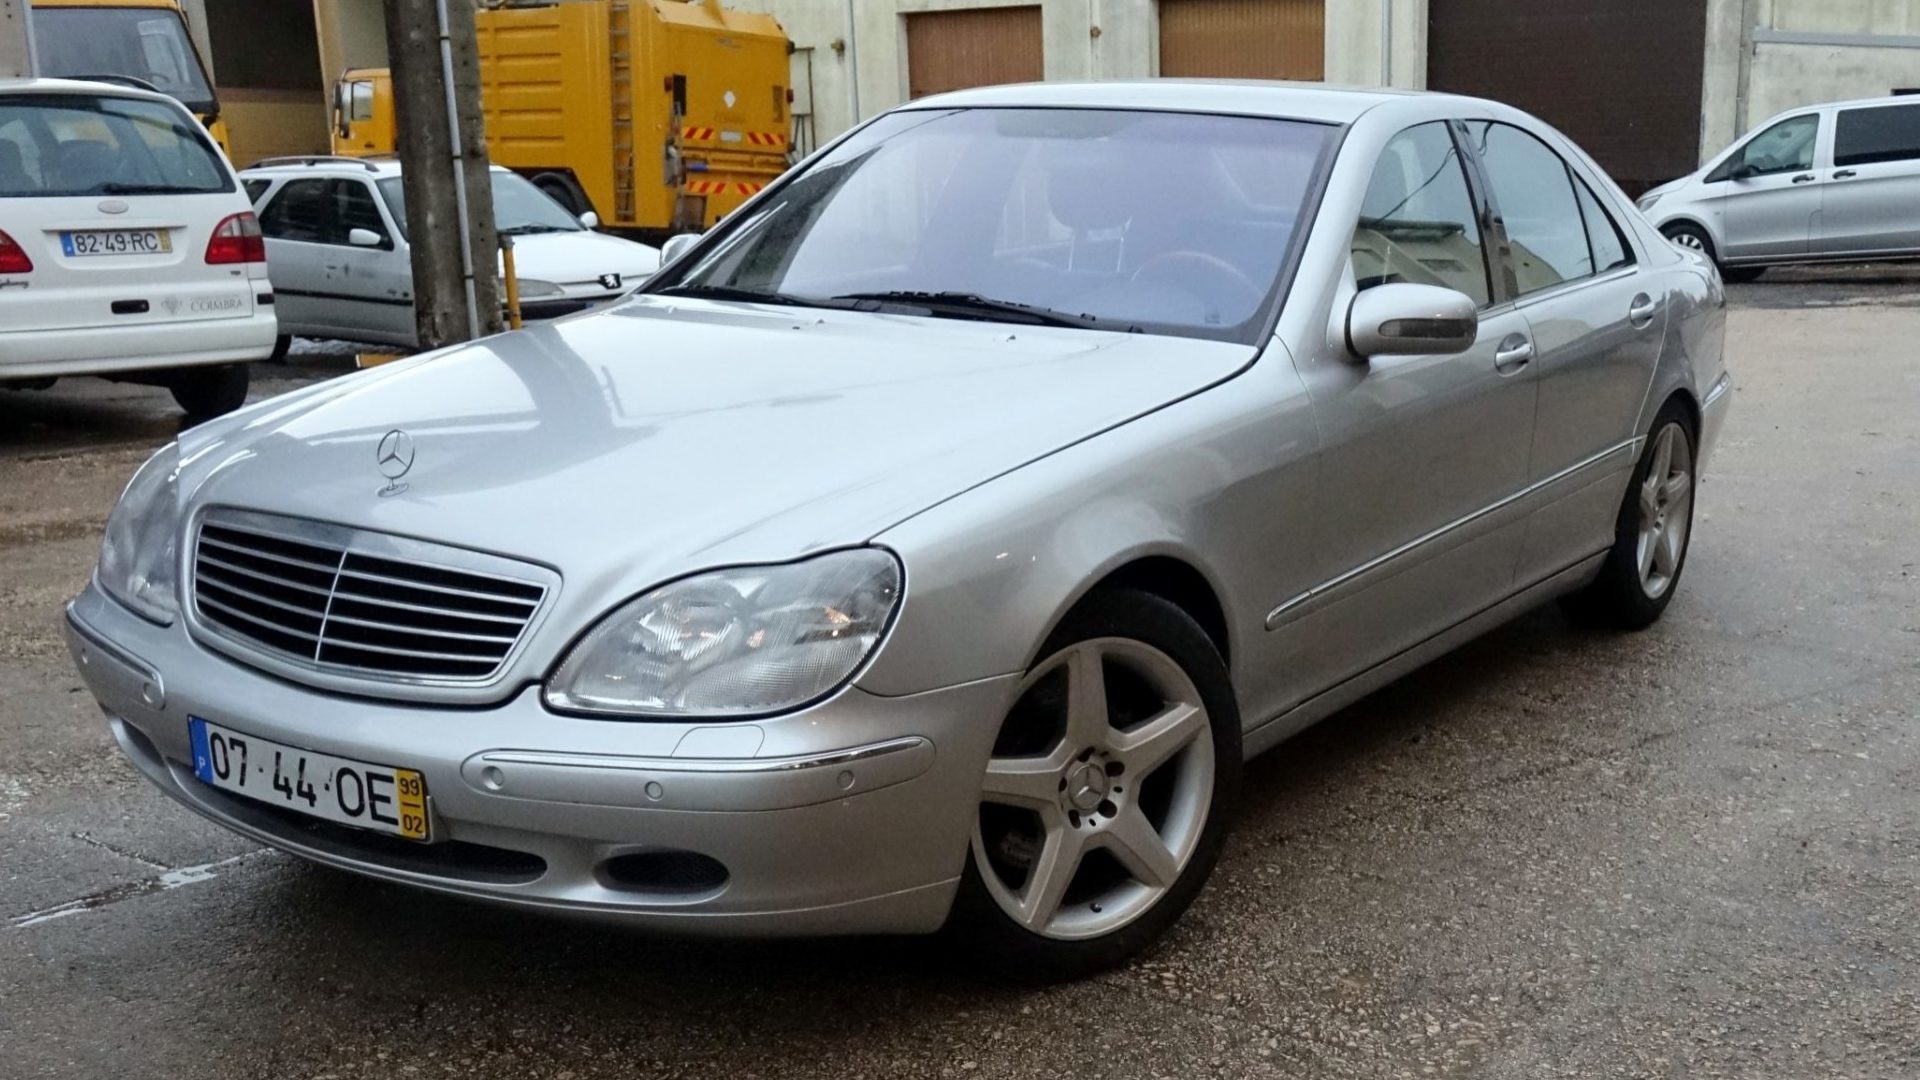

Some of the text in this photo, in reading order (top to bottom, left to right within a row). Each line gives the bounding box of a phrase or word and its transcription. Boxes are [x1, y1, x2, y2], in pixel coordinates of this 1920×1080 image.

[190, 299, 243, 313] COIMBRA
[198, 756, 206, 769] P
[400, 777, 421, 796] 99
[402, 815, 423, 833] 02
